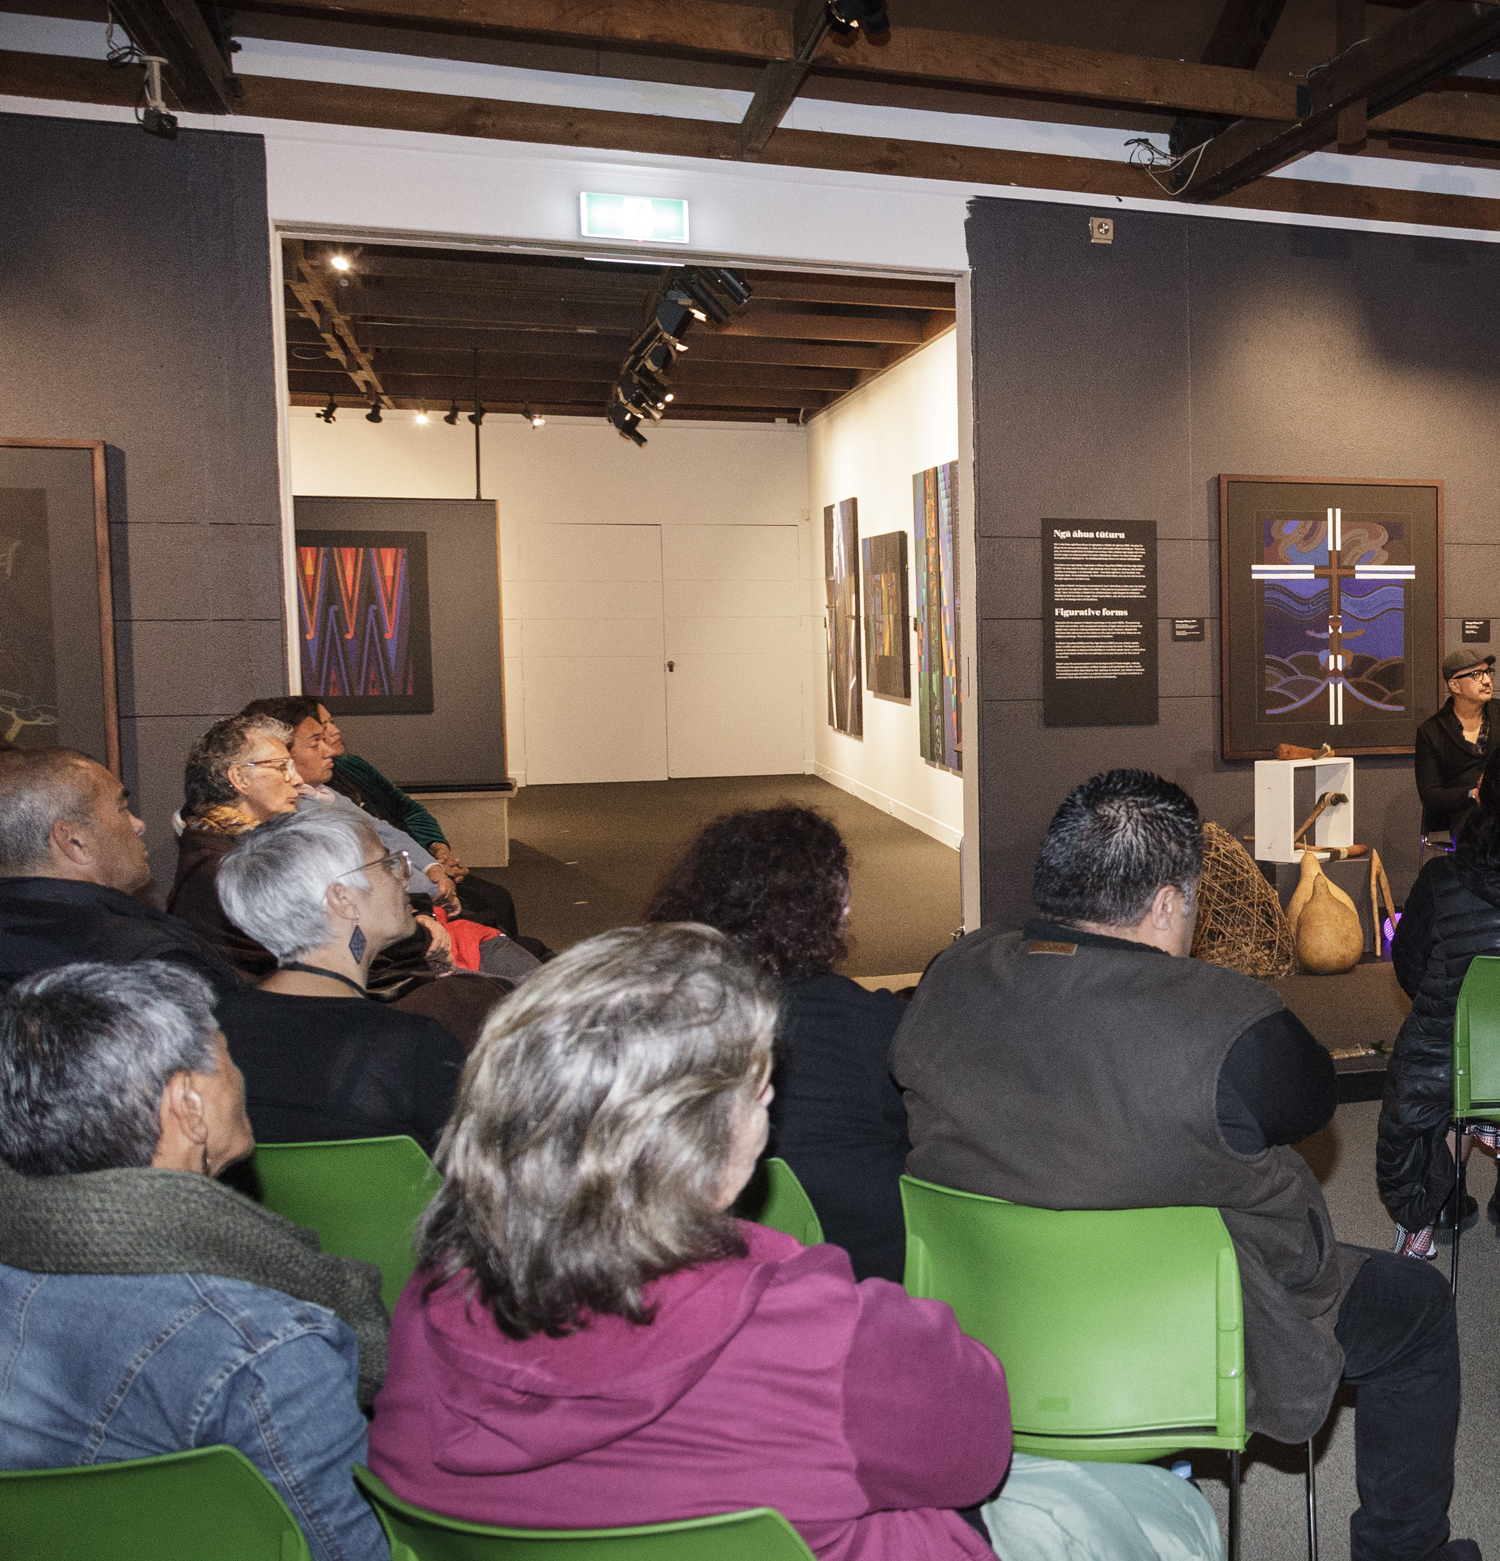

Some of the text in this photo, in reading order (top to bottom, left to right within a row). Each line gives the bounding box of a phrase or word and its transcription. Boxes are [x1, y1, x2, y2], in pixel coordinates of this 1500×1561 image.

[1054, 530, 1071, 539] Ngā
[1054, 608, 1128, 617] Figurative forms
